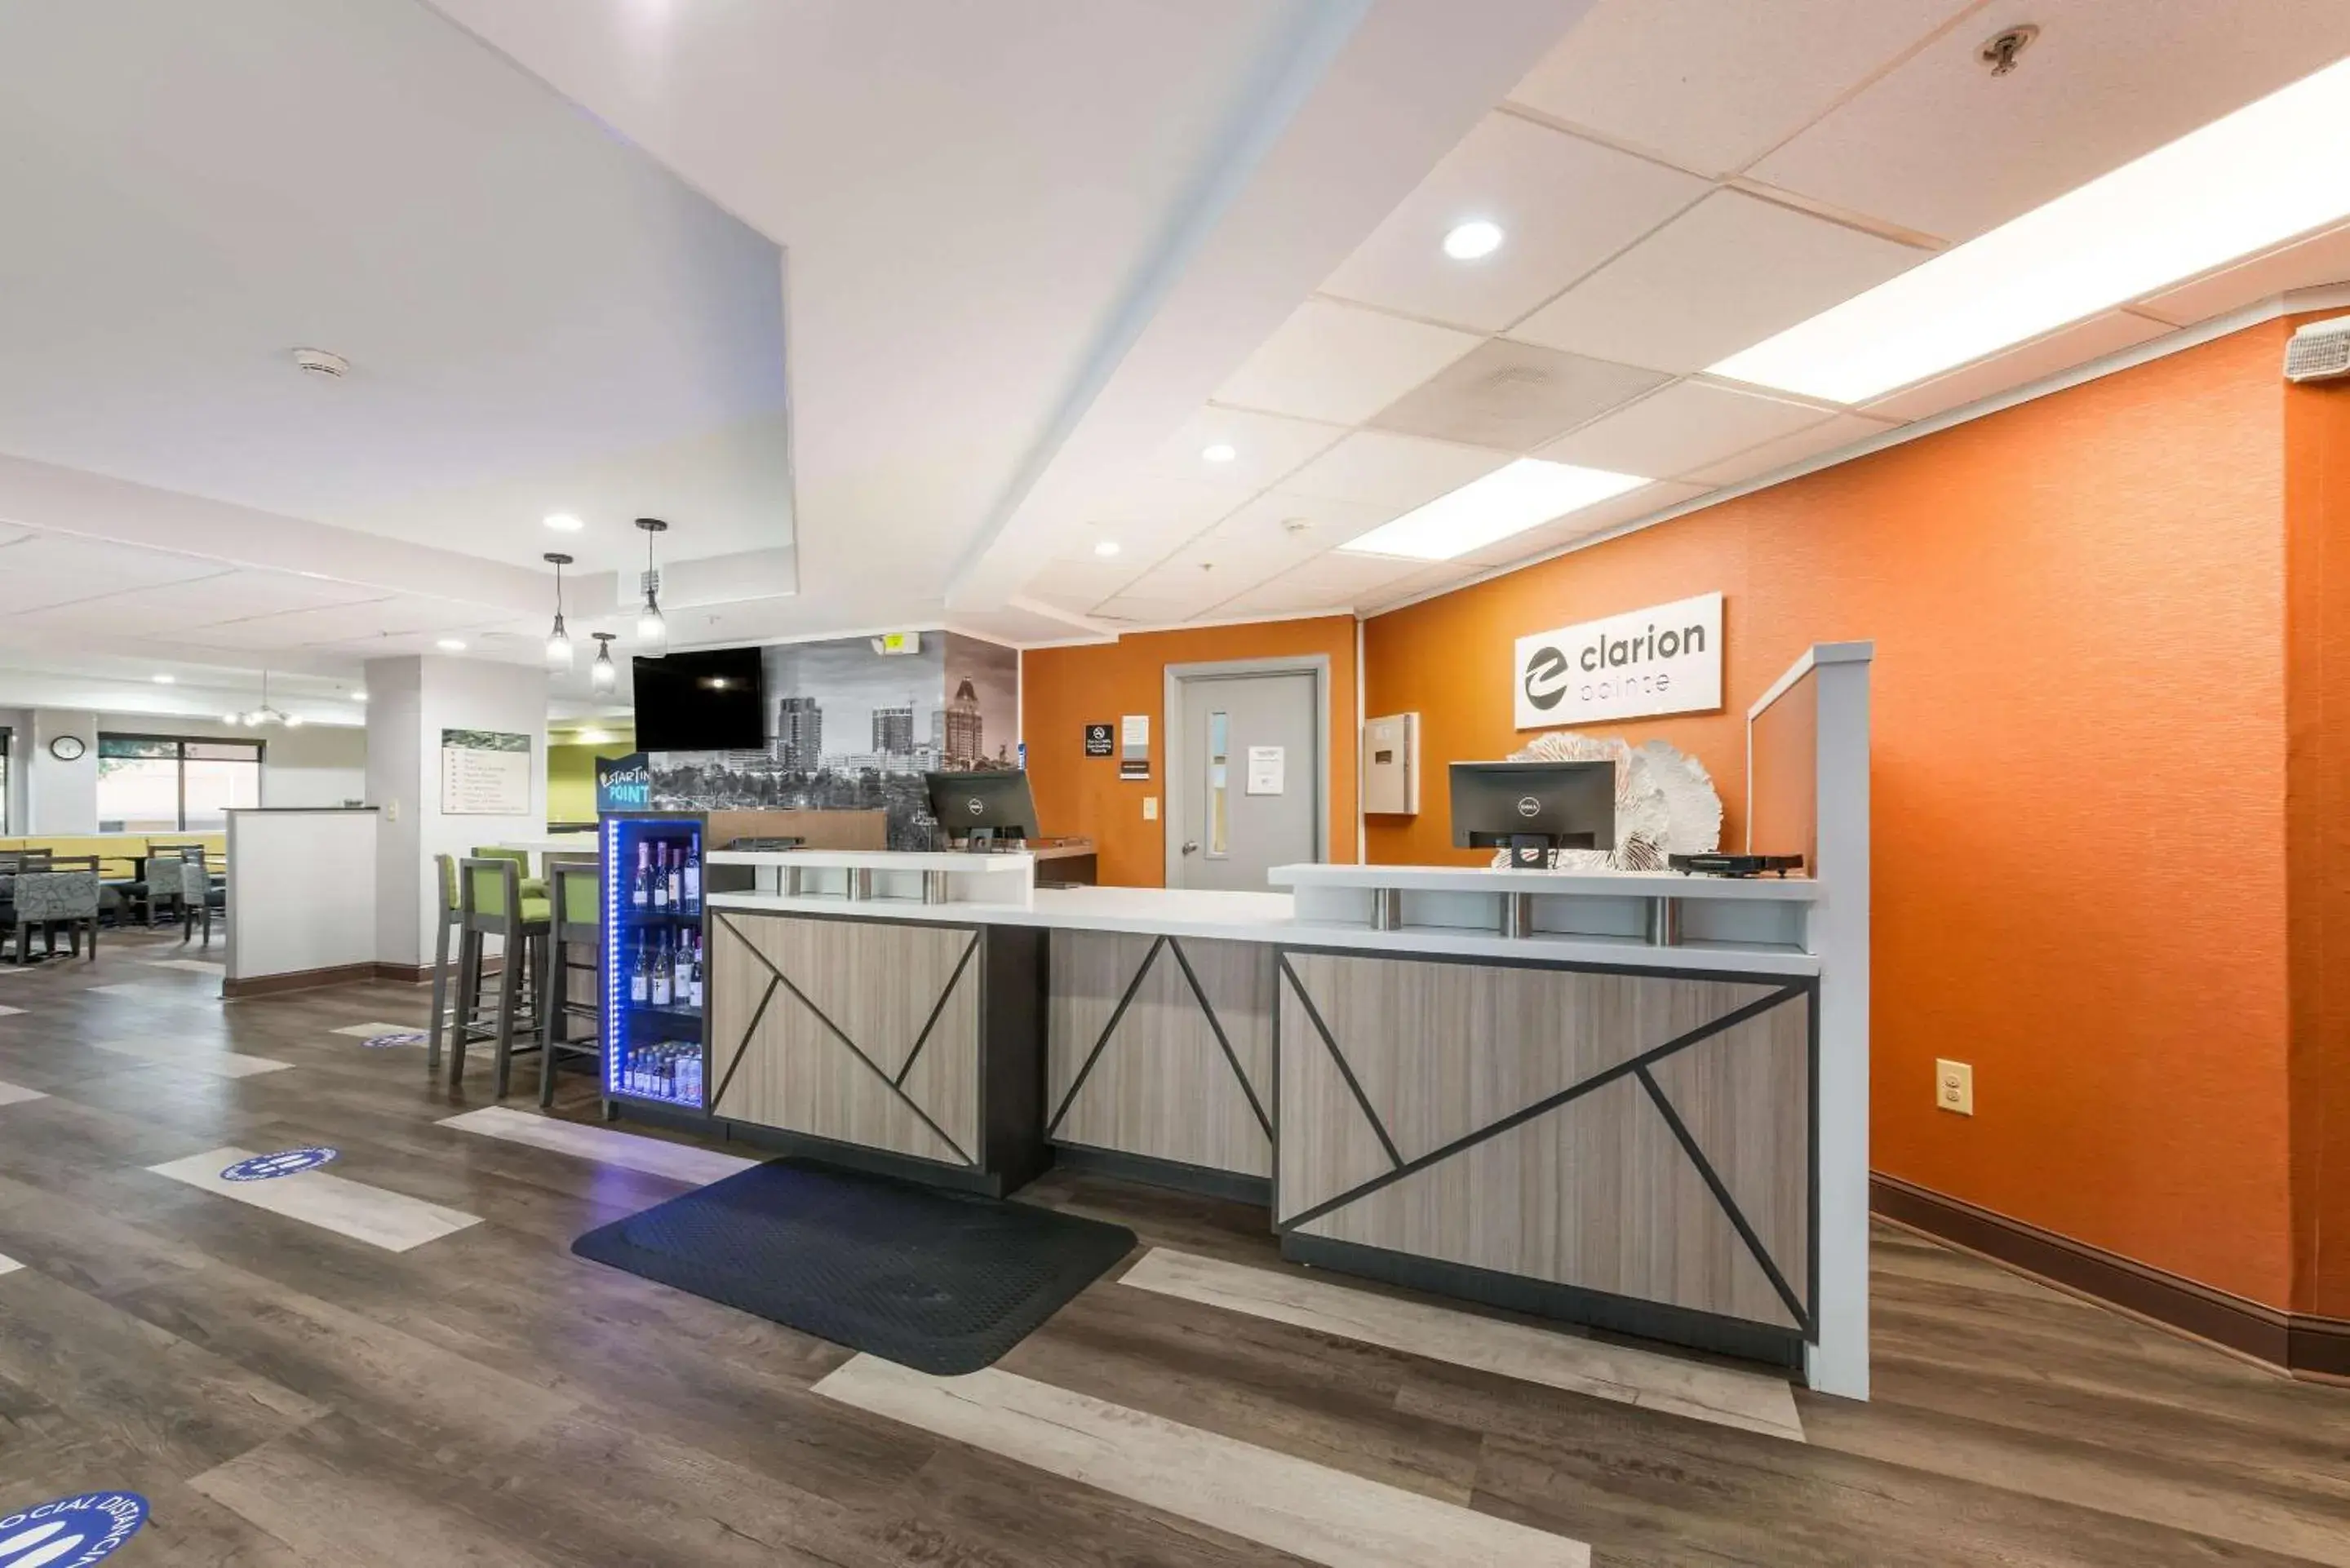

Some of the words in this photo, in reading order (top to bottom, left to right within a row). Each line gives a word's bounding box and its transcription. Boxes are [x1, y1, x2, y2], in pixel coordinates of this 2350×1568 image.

[1581, 623, 1705, 672] clarion
[603, 766, 650, 787] STARTIN
[610, 784, 650, 804] POINT
[0, 1495, 98, 1529] OCIAL
[64, 1495, 140, 1568] DISTANCIN
